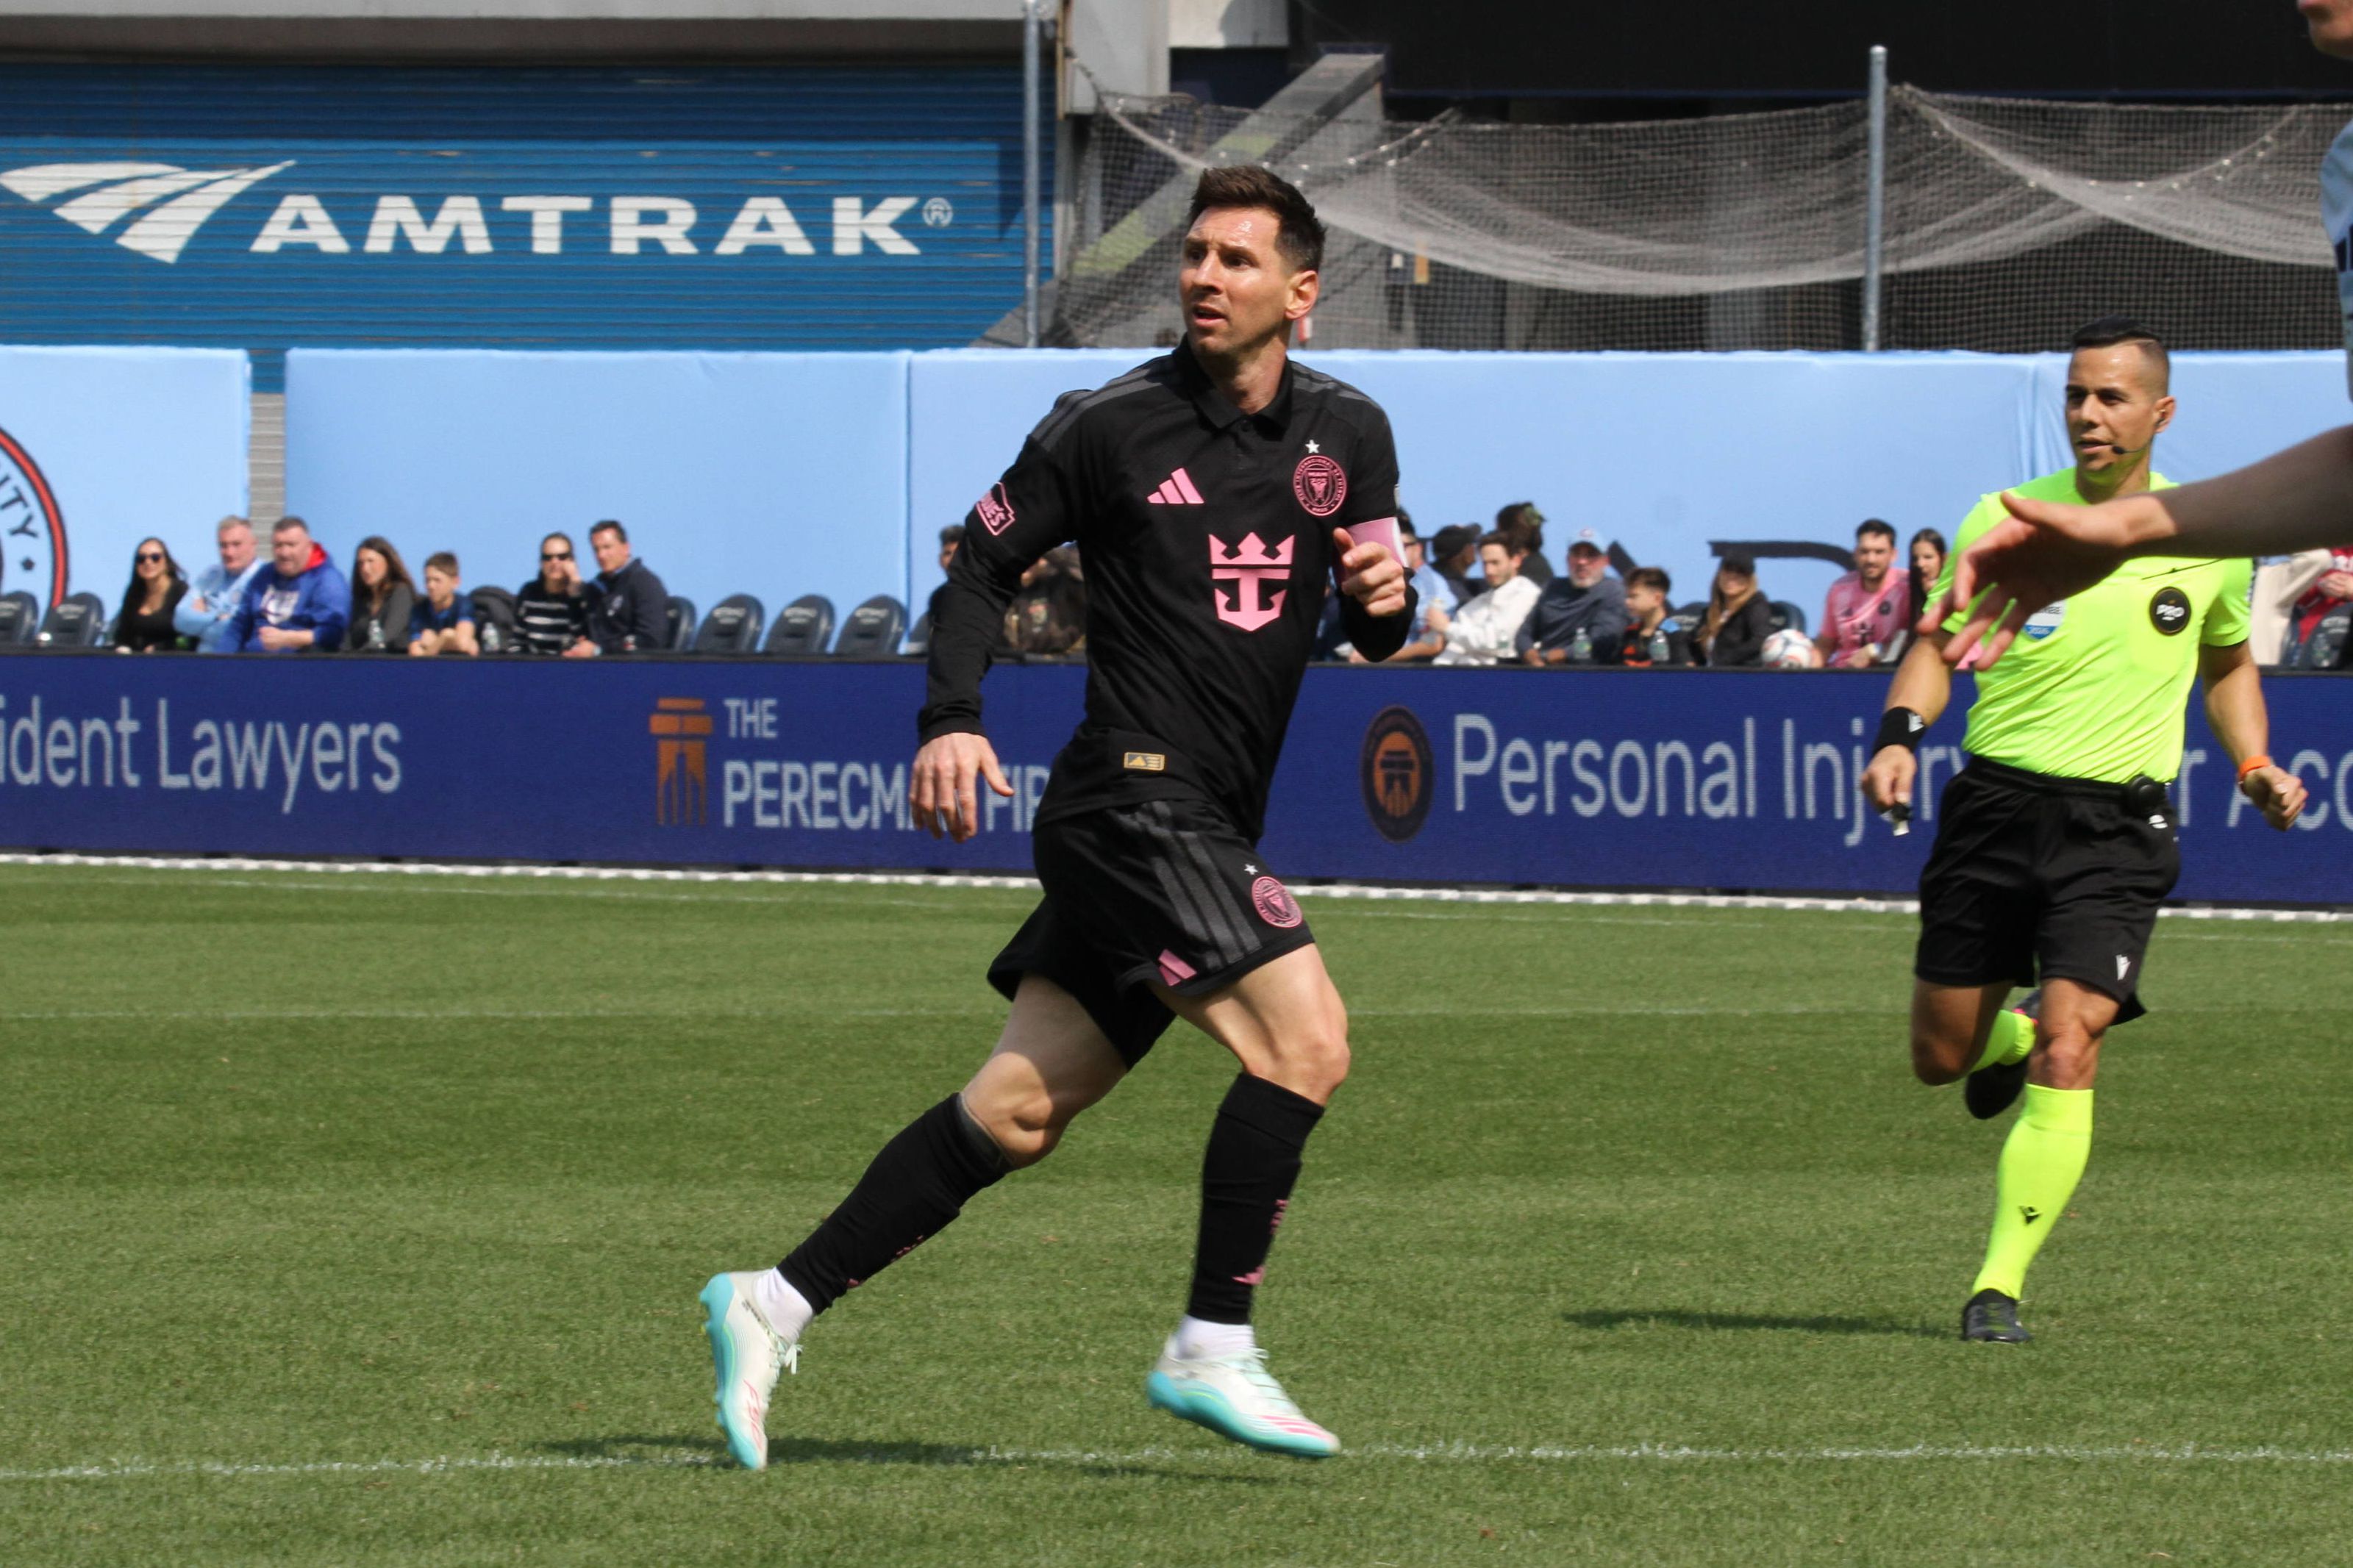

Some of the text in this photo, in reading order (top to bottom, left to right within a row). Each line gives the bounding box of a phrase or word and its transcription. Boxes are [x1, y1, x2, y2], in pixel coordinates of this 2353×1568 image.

[0, 474, 38, 539] ITY
[724, 698, 777, 738] THE
[158, 698, 401, 814] Lawyers
[1453, 713, 1965, 846] Personal Injr
[724, 760, 1051, 833] PERECM FIR
